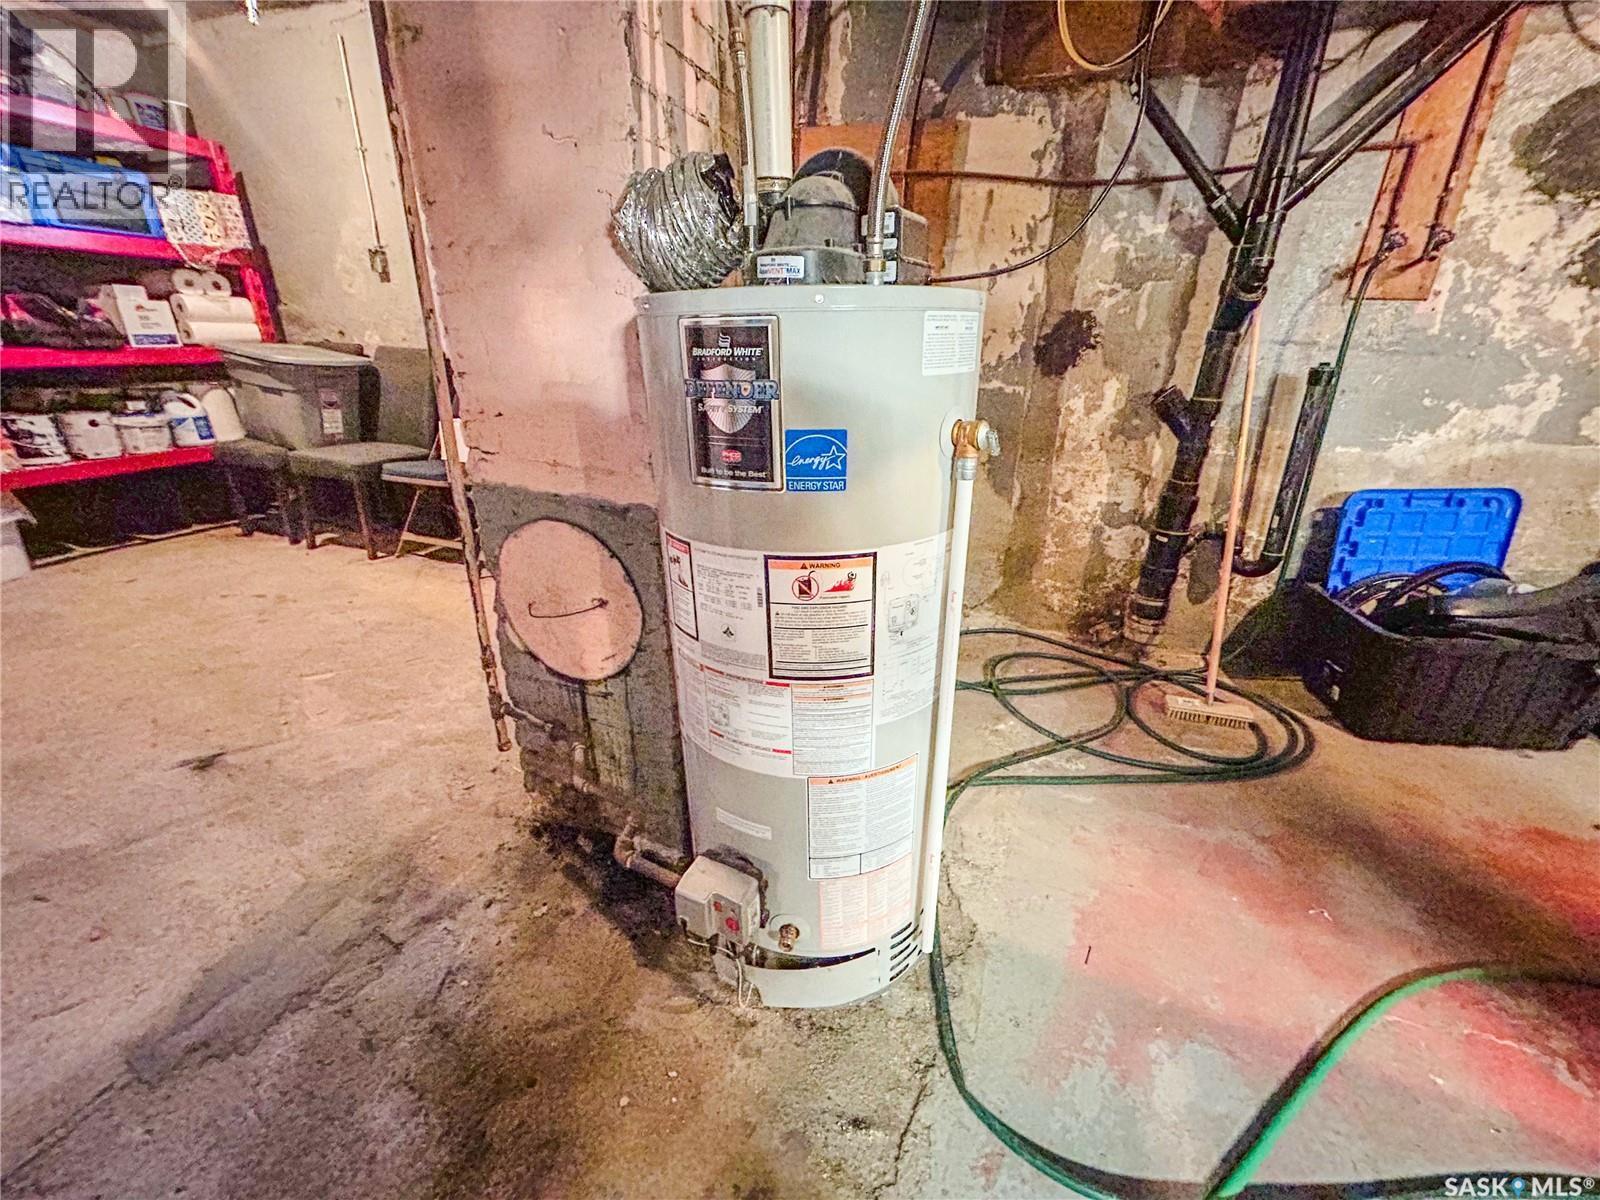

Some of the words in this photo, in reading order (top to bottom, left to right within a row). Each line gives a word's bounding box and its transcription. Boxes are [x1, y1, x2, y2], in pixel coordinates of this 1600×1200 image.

[692, 347, 732, 356] BRADFORD
[788, 481, 822, 490] ENERGY
[823, 481, 844, 490] STAR
